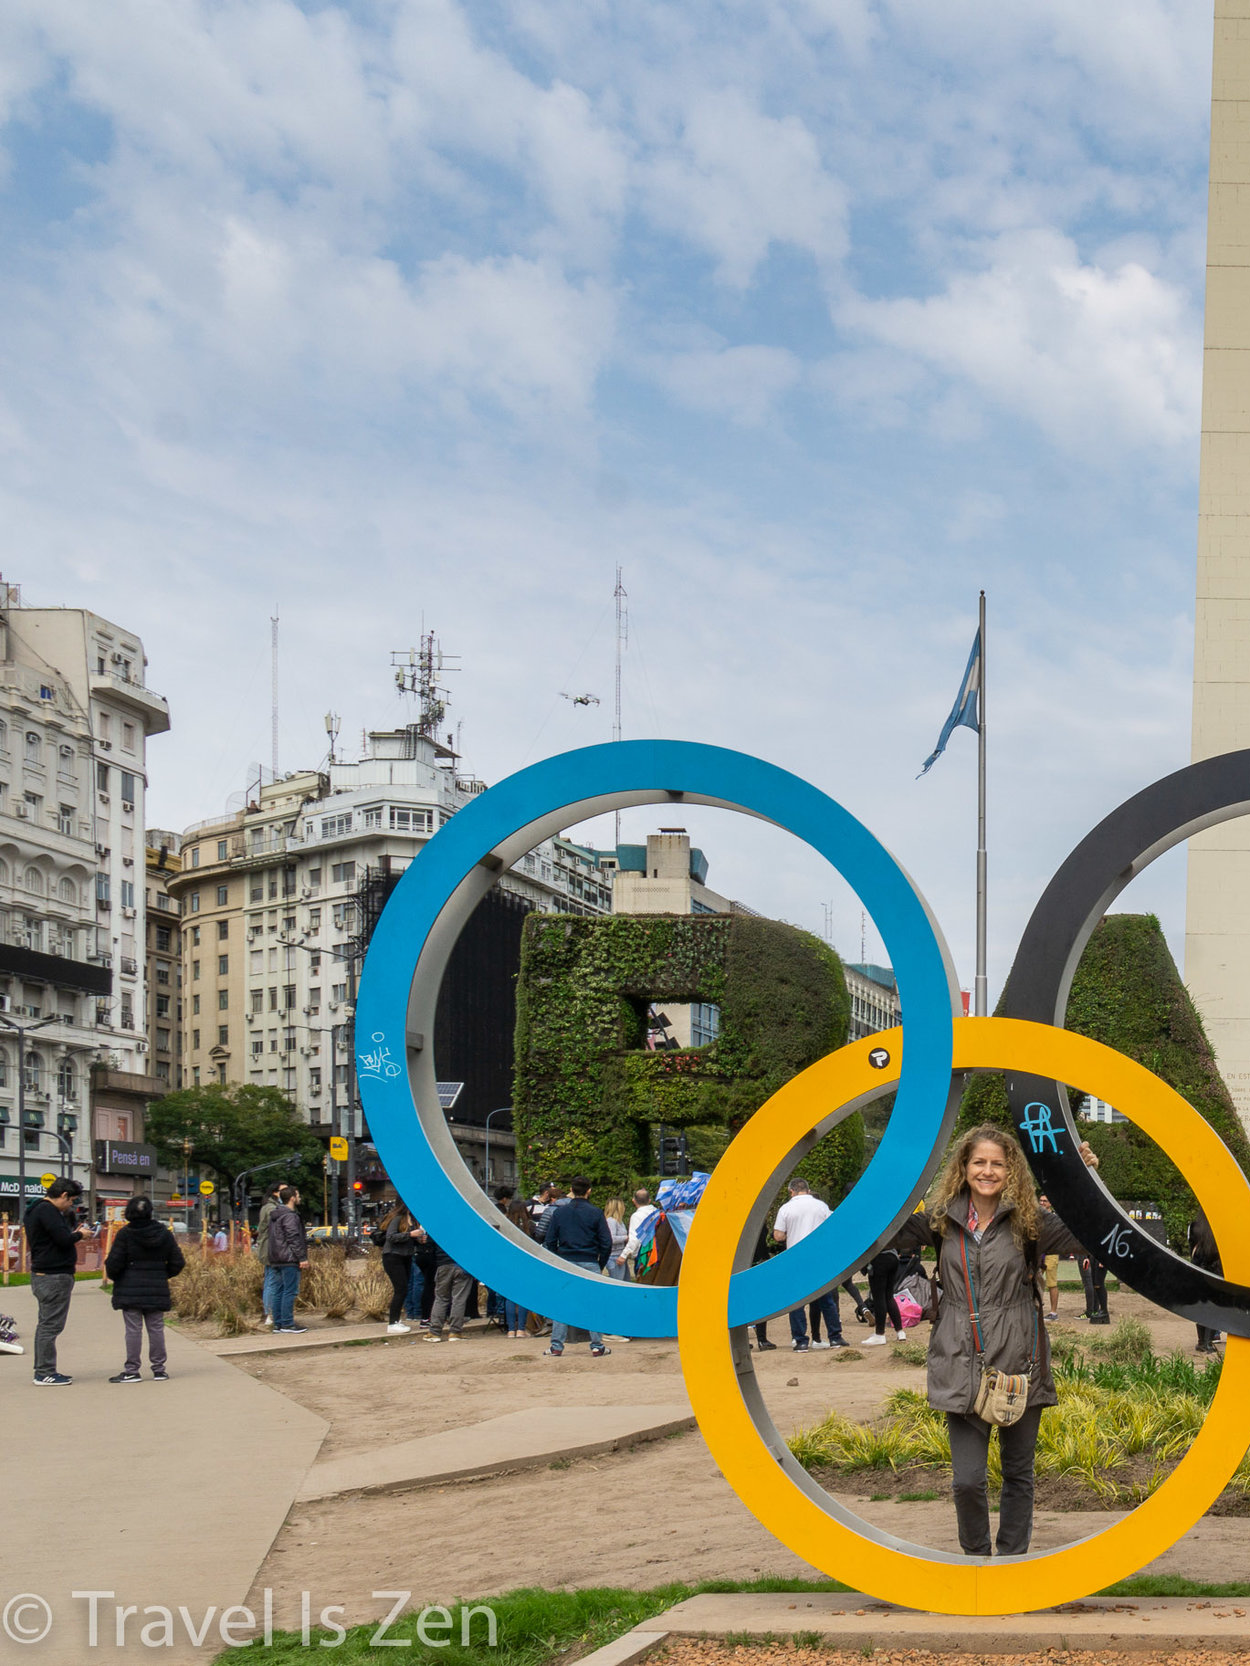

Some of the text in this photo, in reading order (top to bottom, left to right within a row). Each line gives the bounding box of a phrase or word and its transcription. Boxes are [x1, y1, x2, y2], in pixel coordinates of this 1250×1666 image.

[112, 1149, 150, 1166] Pensá en
[1, 1181, 47, 1194] McDnald's
